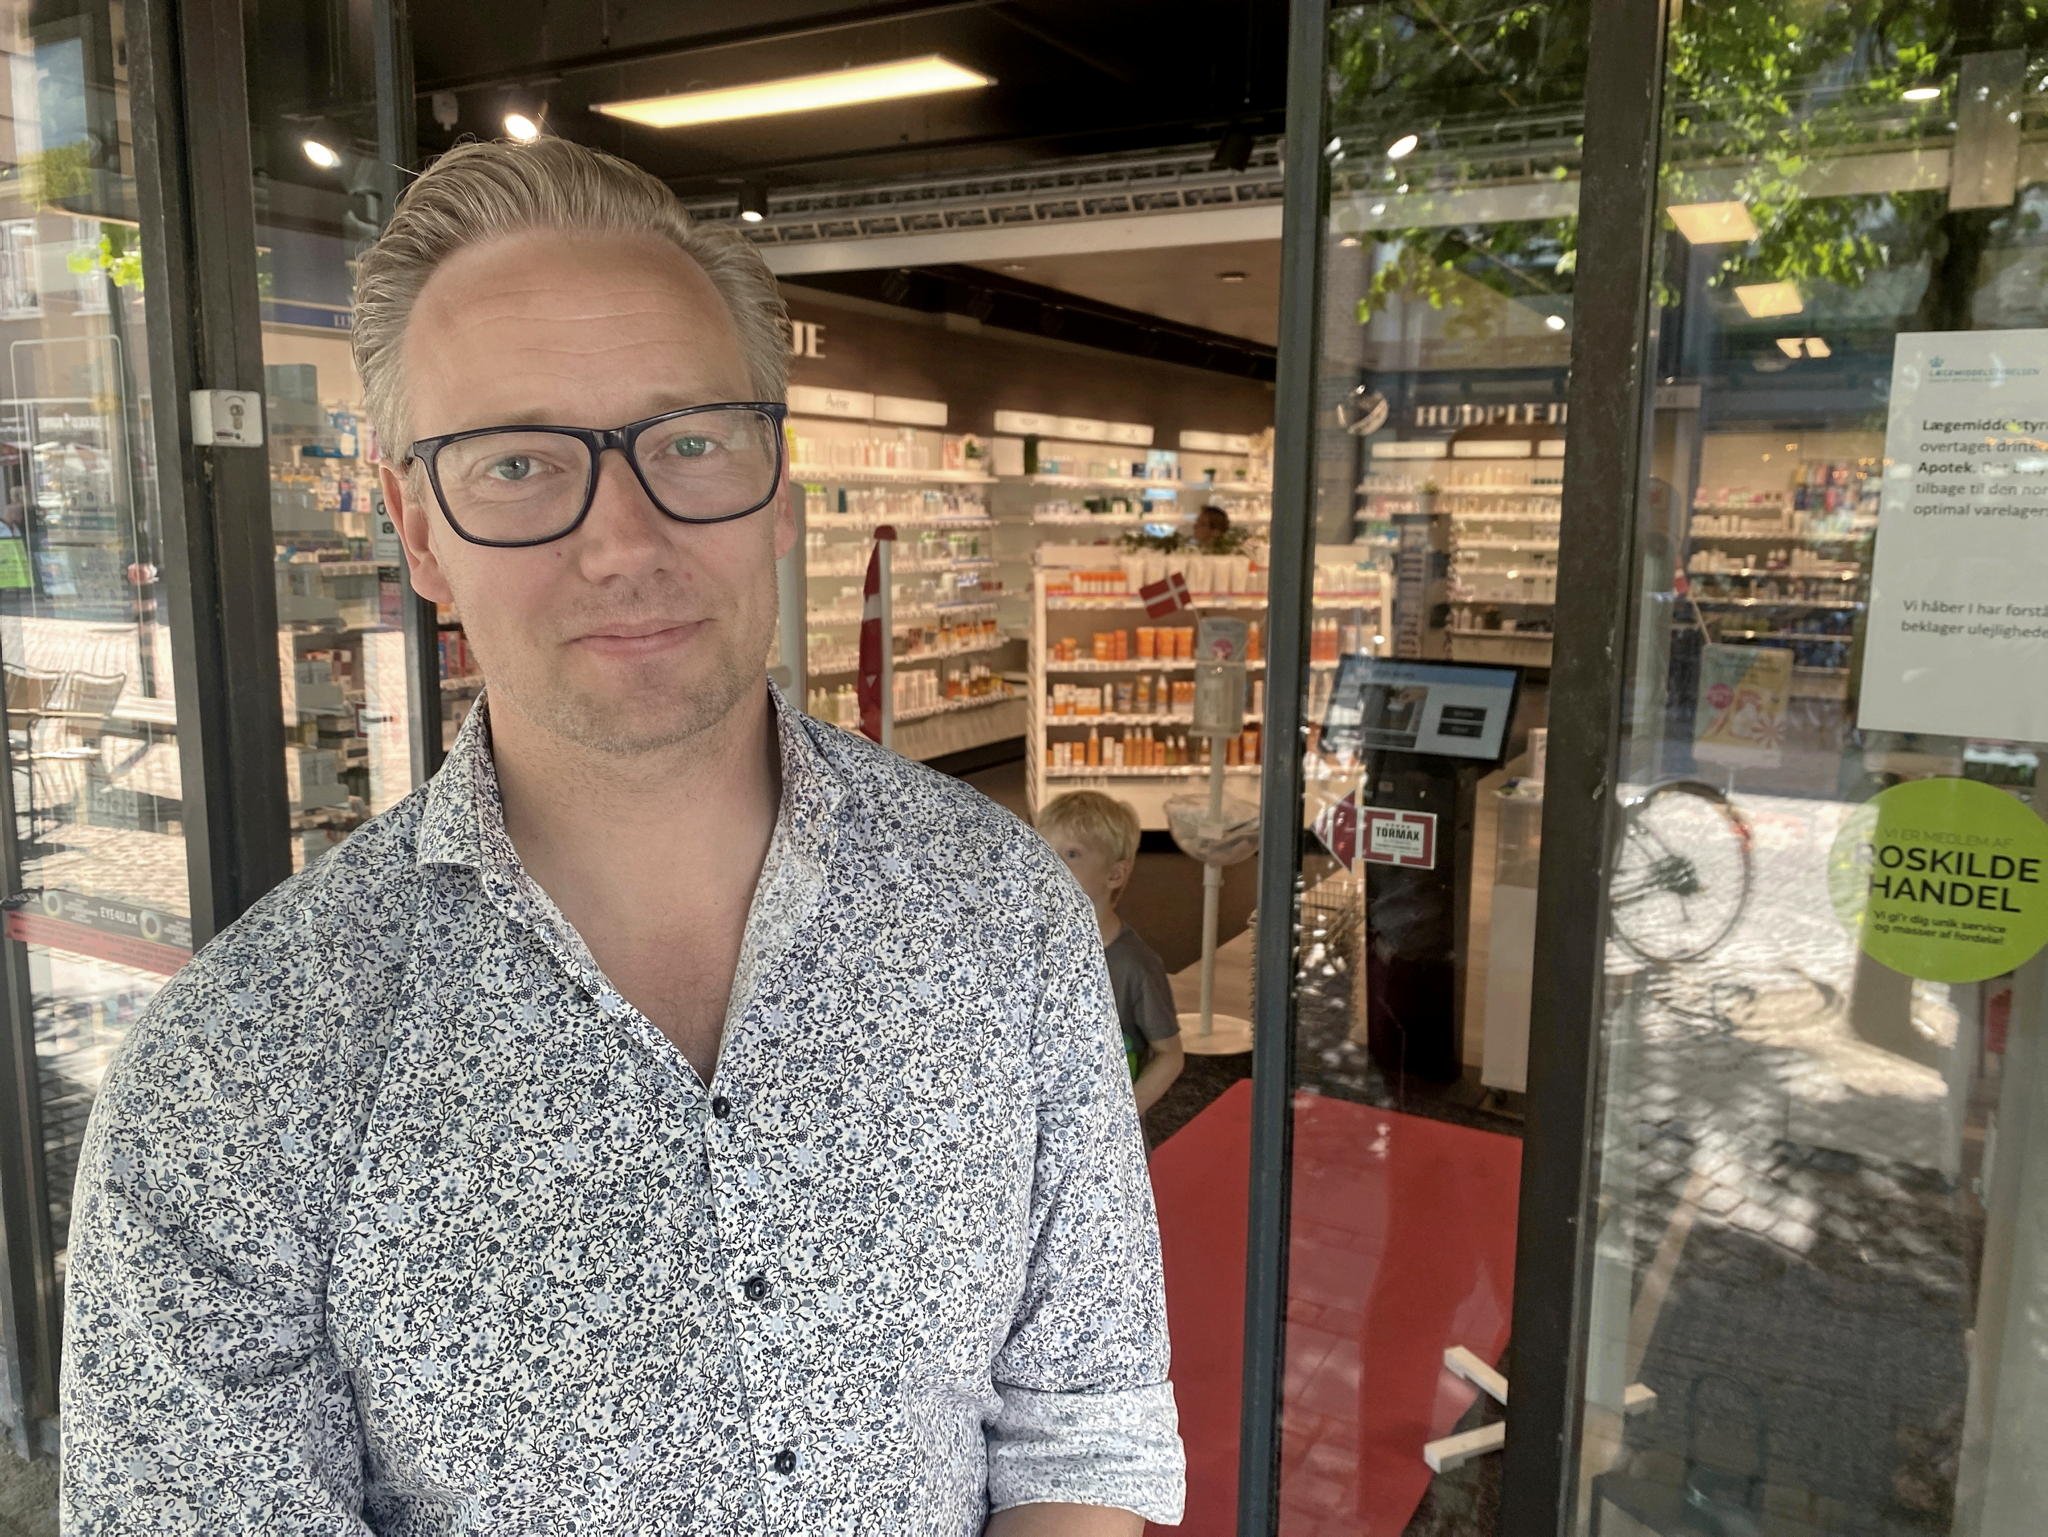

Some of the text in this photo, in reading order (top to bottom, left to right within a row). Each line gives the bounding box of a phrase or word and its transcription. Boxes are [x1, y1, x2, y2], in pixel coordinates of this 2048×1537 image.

[1920, 442, 1992, 455] overtaget
[1916, 483, 1965, 497] tilbage
[1970, 483, 1985, 494] til
[1988, 482, 2017, 495] den
[1913, 504, 1971, 517] optimal
[1903, 600, 1918, 612] Vi
[1921, 600, 1964, 613] håber
[1977, 603, 2002, 615] har
[1901, 620, 1964, 635] beklager
[1376, 826, 1420, 841] TORMAX
[1868, 875, 2022, 913] HANDEL
